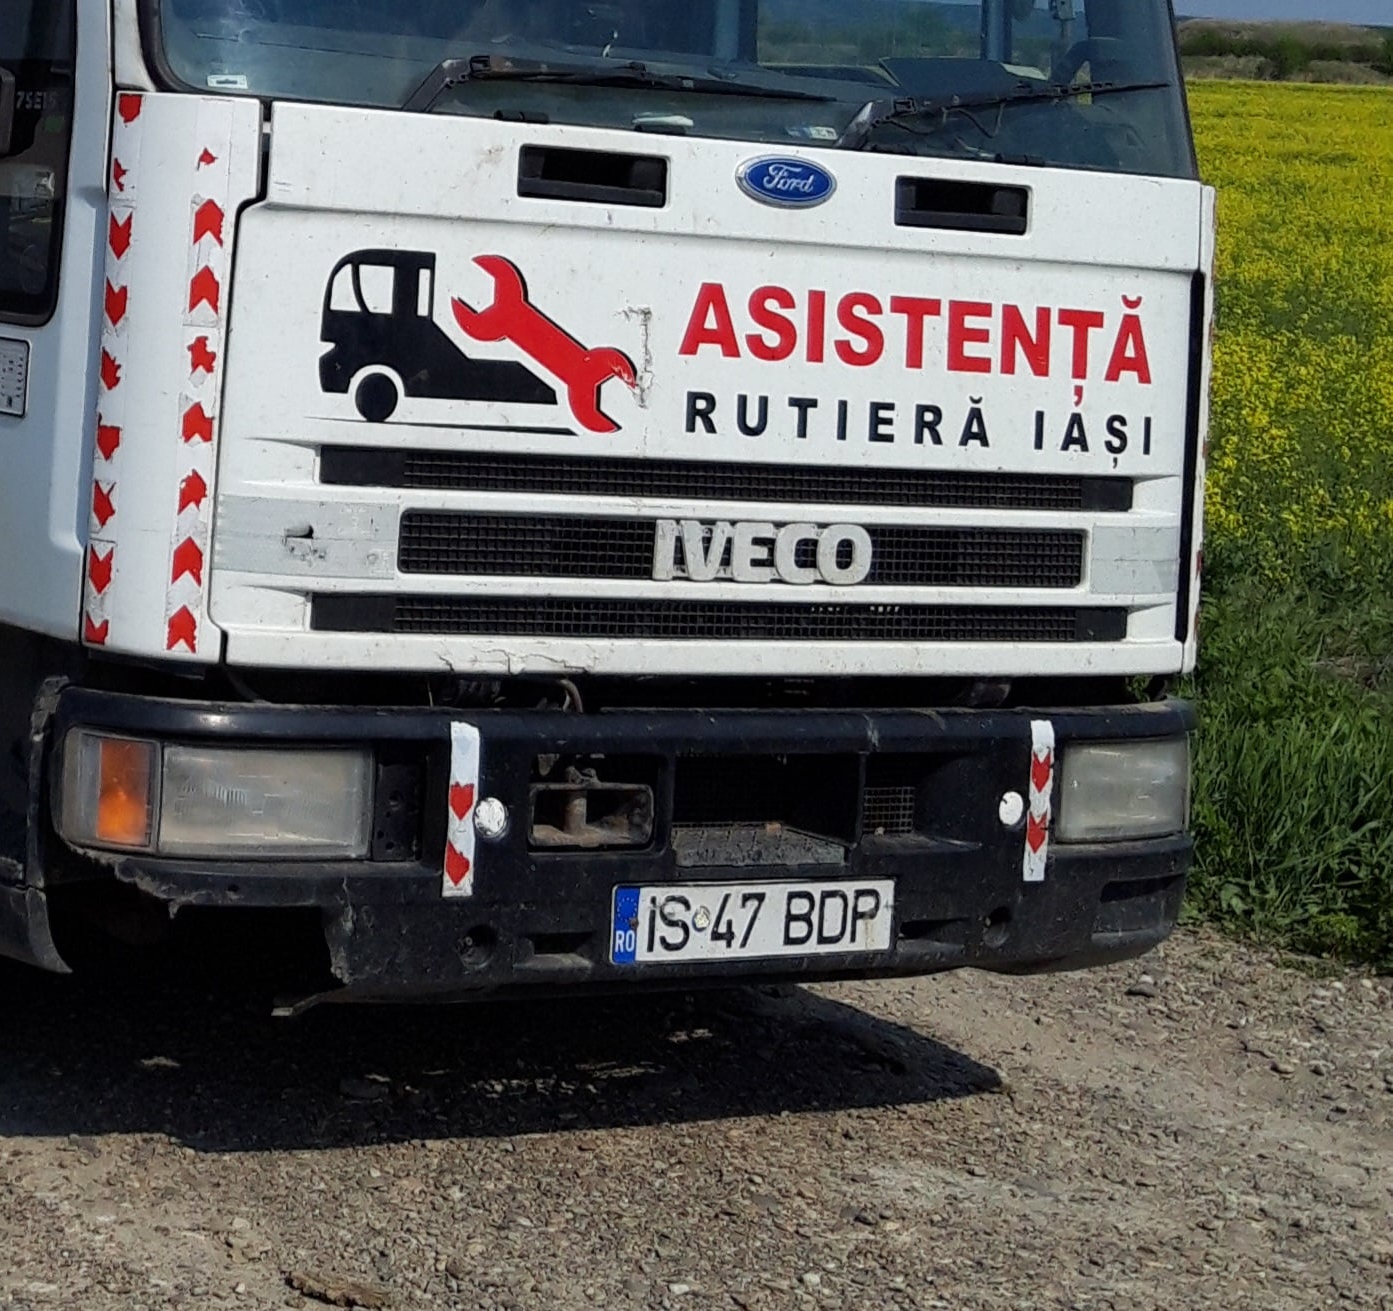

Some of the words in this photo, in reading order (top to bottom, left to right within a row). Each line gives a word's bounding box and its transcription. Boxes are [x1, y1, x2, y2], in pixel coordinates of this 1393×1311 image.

[763, 163, 815, 193] Ford
[678, 282, 1152, 406] ASISTENȚĂ
[685, 390, 990, 448] RUTIERĂ
[1033, 410, 1152, 469] IAȘI
[651, 519, 873, 585] IVECO
[615, 930, 635, 953] RO
[646, 894, 691, 952] IS
[709, 891, 767, 949] 47
[782, 888, 881, 946] BDP
